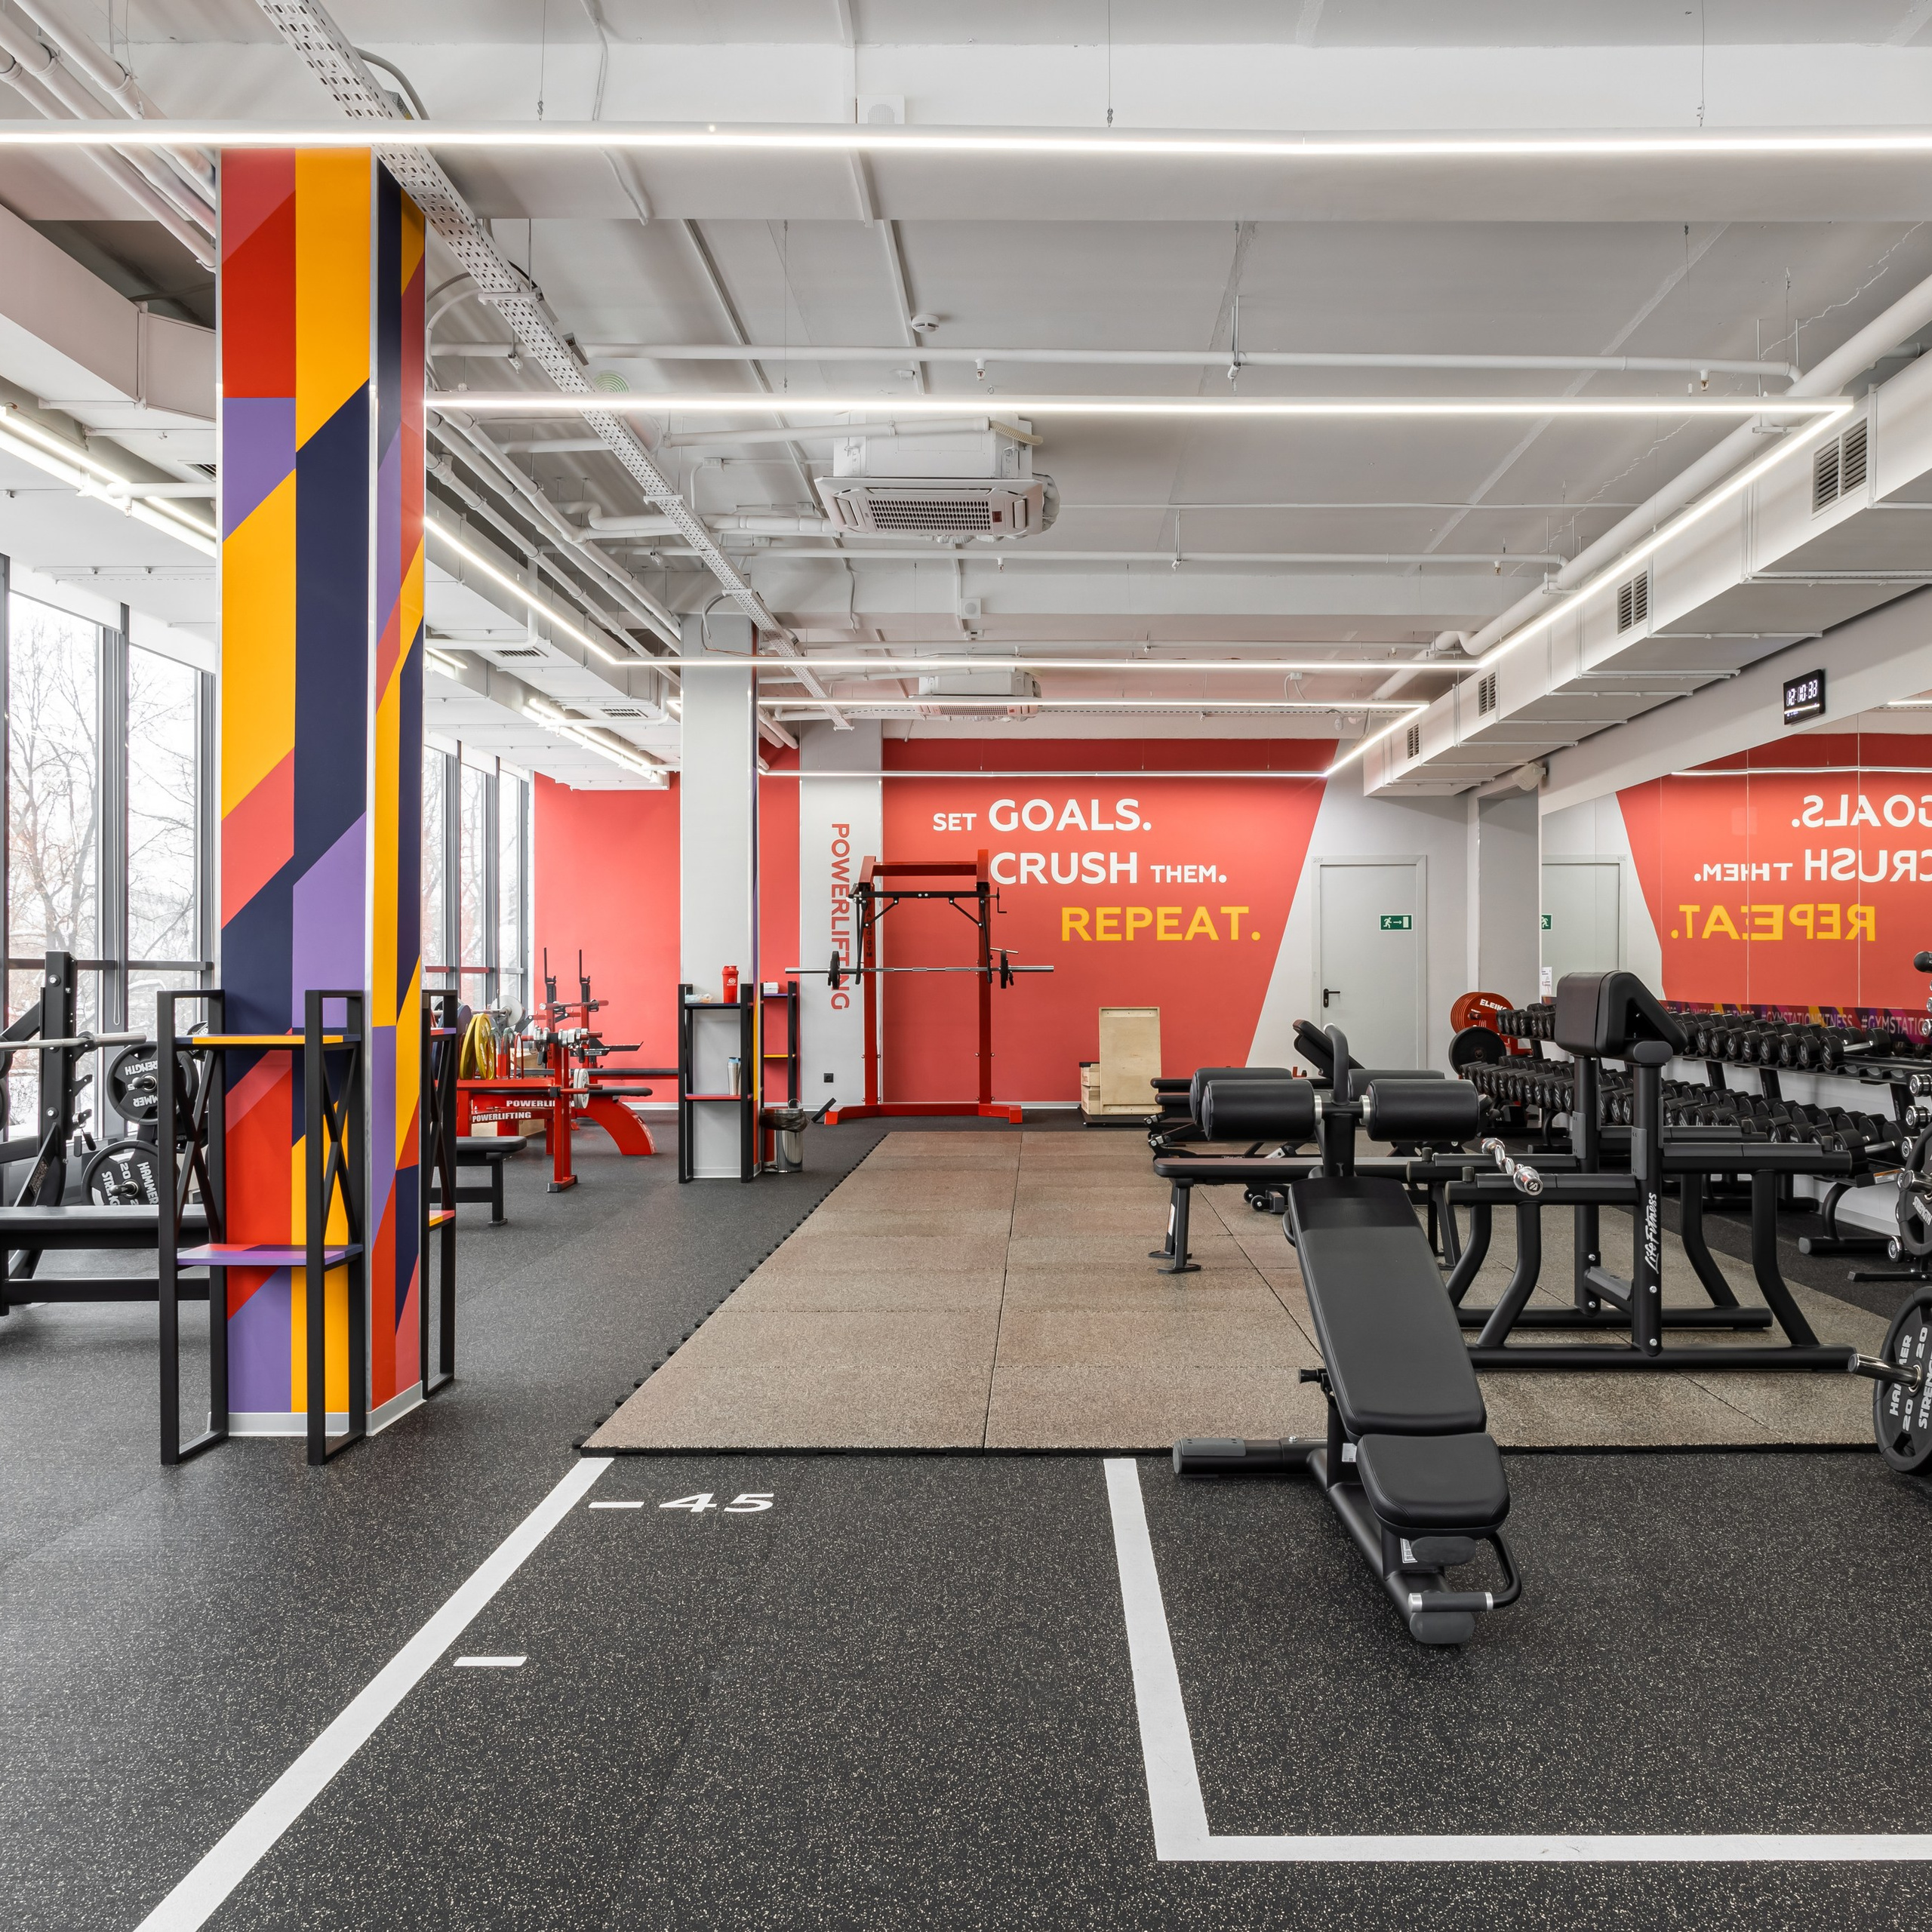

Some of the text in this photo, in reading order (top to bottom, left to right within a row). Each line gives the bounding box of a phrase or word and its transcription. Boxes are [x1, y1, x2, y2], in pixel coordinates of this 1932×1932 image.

[933, 798, 1152, 832] SET GOALS.
[990, 851, 1227, 884] CRUSH THEM.
[831, 823, 850, 1010] POWERLIFTNG
[1062, 906, 1260, 941] REPEAT.
[125, 1060, 158, 1075] RENGTH
[133, 1095, 158, 1107] MMER
[472, 1112, 531, 1122] POWERLIFTING
[120, 1162, 131, 1180] 20
[137, 1161, 159, 1204] HAMMER
[1916, 1327, 1928, 1358] 20
[1903, 1398, 1914, 1431] 20
[658, 1493, 774, 1512] 45
